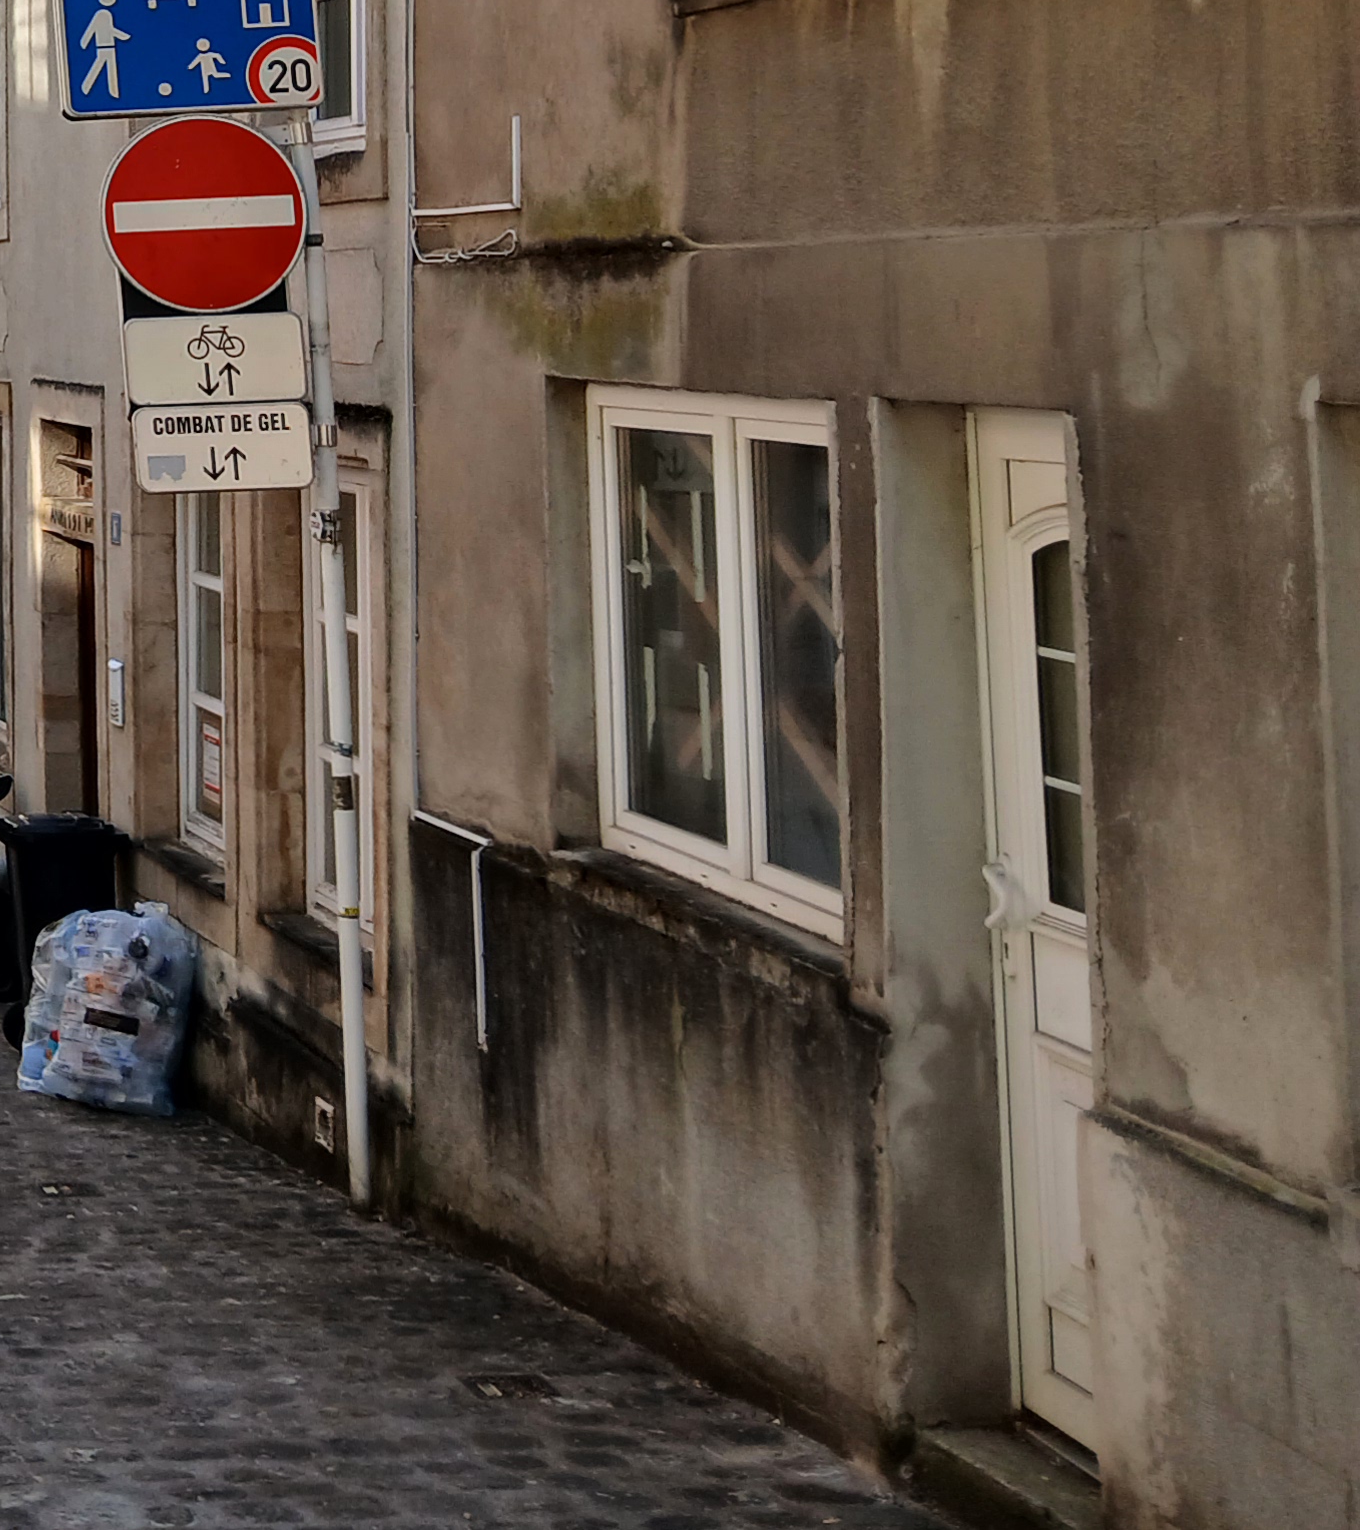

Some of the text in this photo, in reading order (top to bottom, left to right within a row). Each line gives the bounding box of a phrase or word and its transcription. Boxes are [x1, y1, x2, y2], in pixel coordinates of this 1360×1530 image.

[267, 58, 312, 93] 20
[152, 412, 291, 436] COMBAT DE GEL
